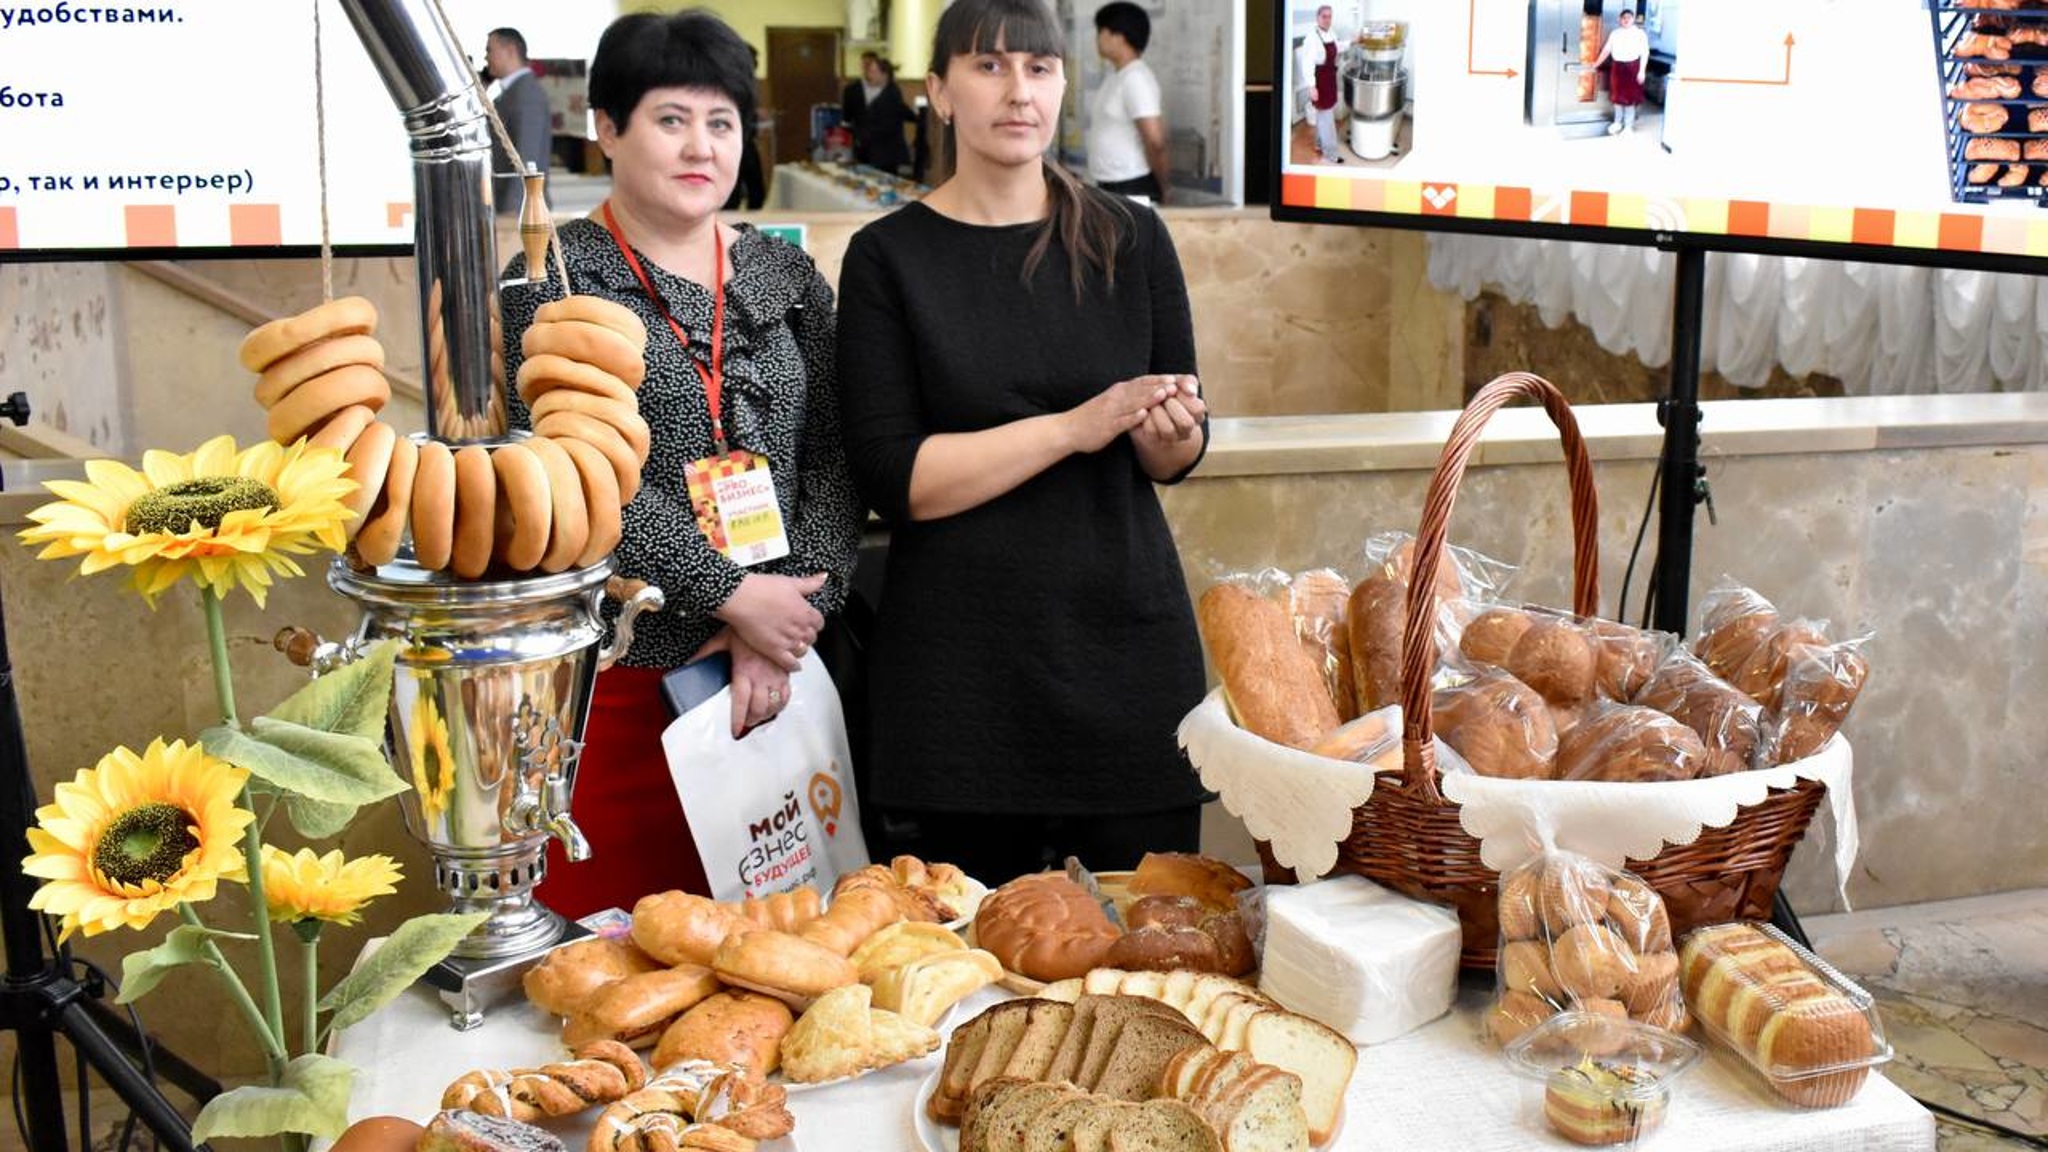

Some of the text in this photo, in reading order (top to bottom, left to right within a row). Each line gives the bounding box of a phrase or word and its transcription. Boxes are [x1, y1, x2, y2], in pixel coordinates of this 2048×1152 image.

[0, 1, 184, 29] удобствами.
[28, 175, 74, 190] так
[83, 175, 99, 190] и
[108, 169, 253, 195] интерьер)
[749, 790, 801, 842] МОЙ
